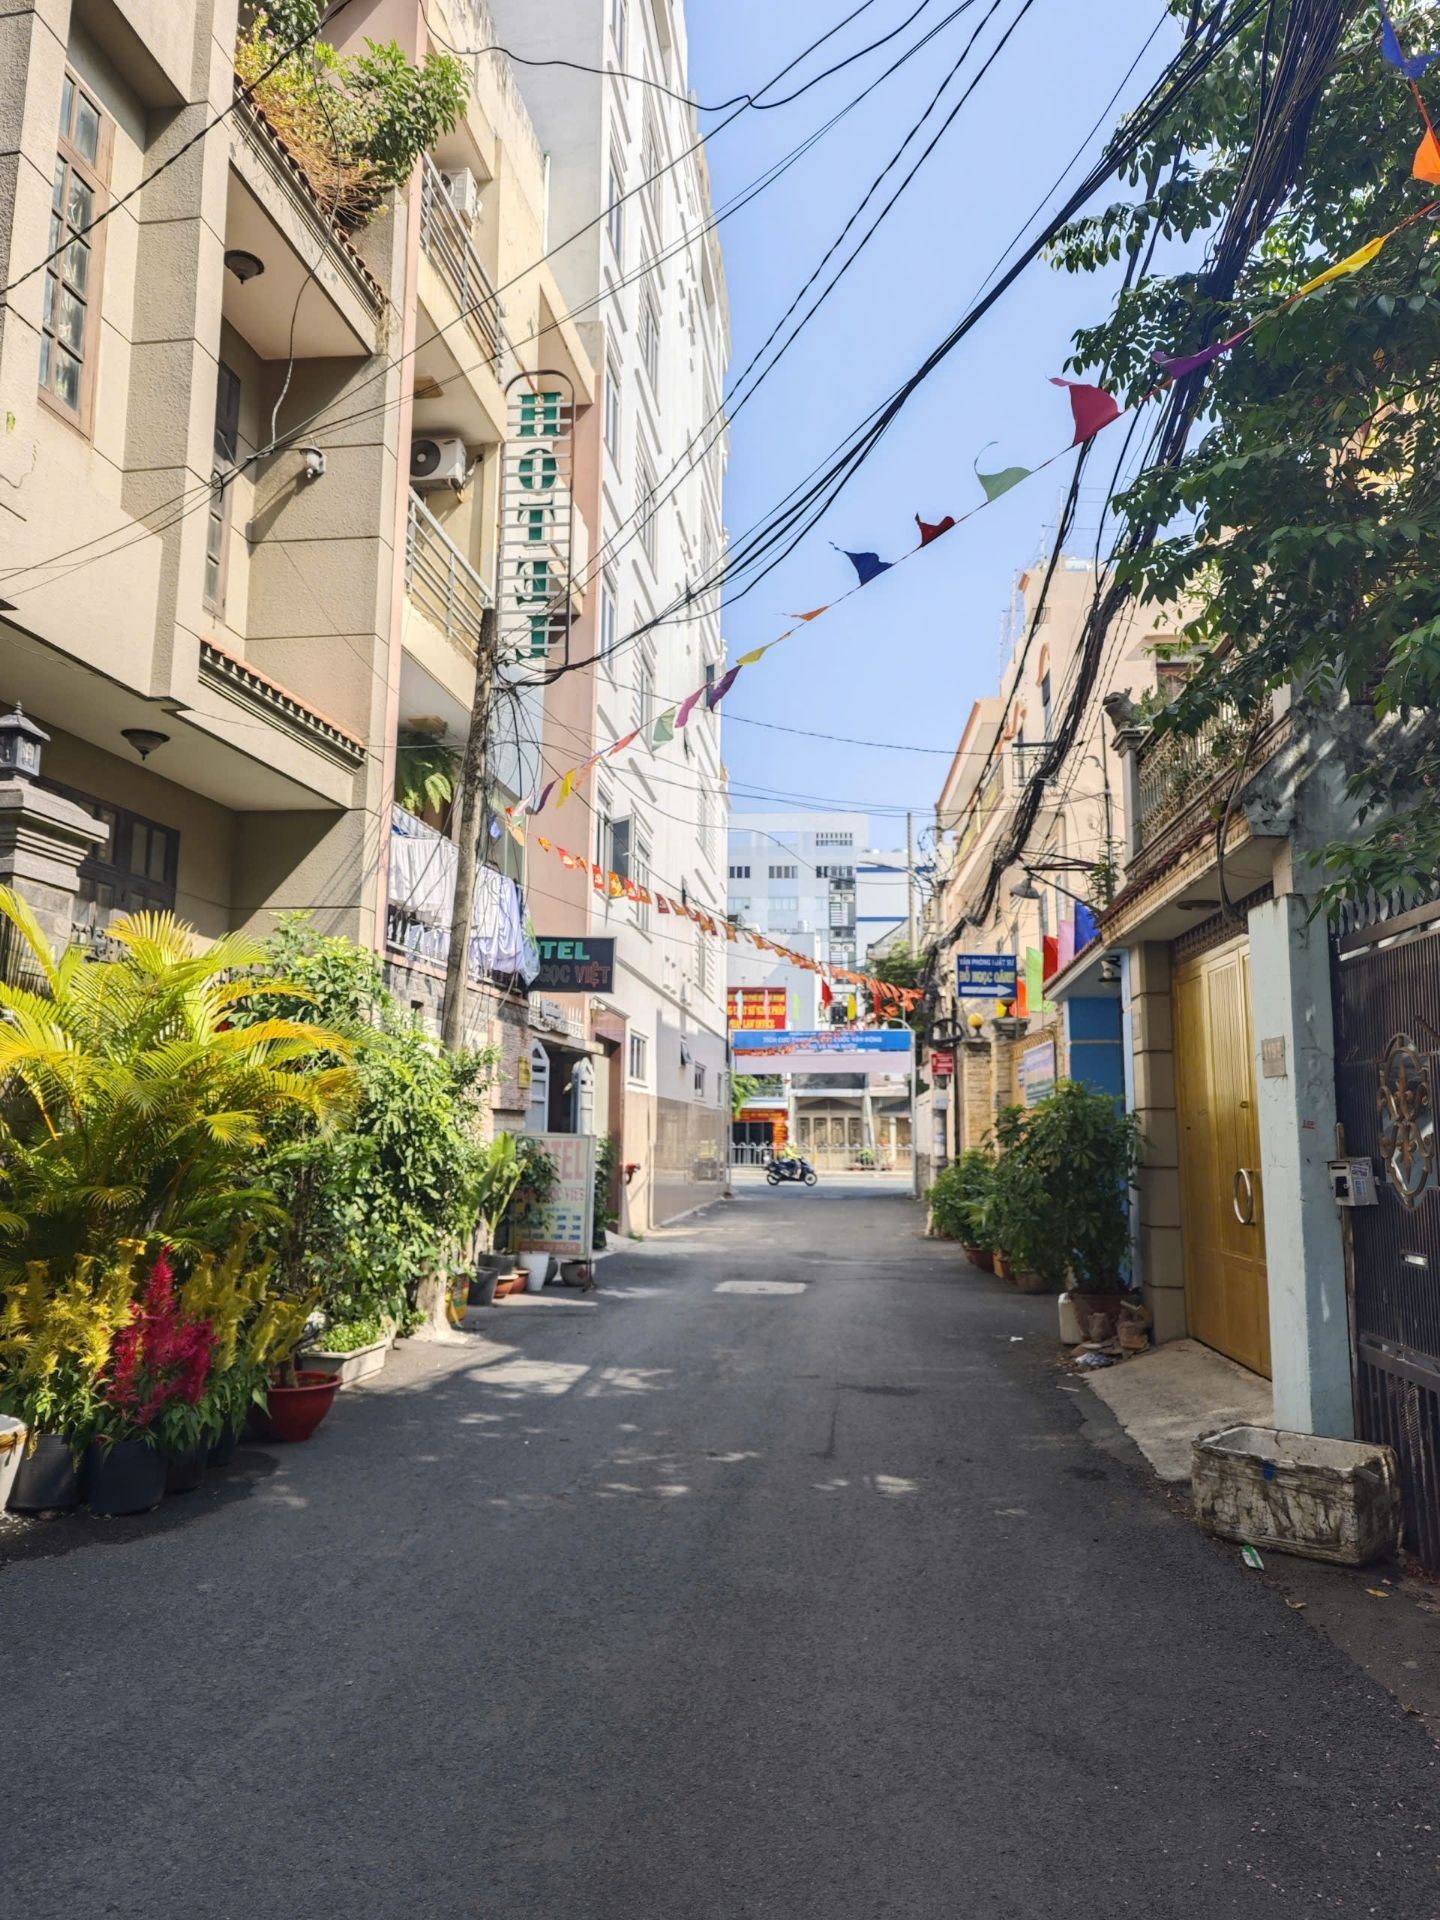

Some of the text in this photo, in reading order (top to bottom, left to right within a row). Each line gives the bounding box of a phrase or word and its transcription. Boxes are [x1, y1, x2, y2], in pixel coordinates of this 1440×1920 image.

[540, 941, 590, 960] TEL
[540, 961, 611, 988] GỌC VIỆT
